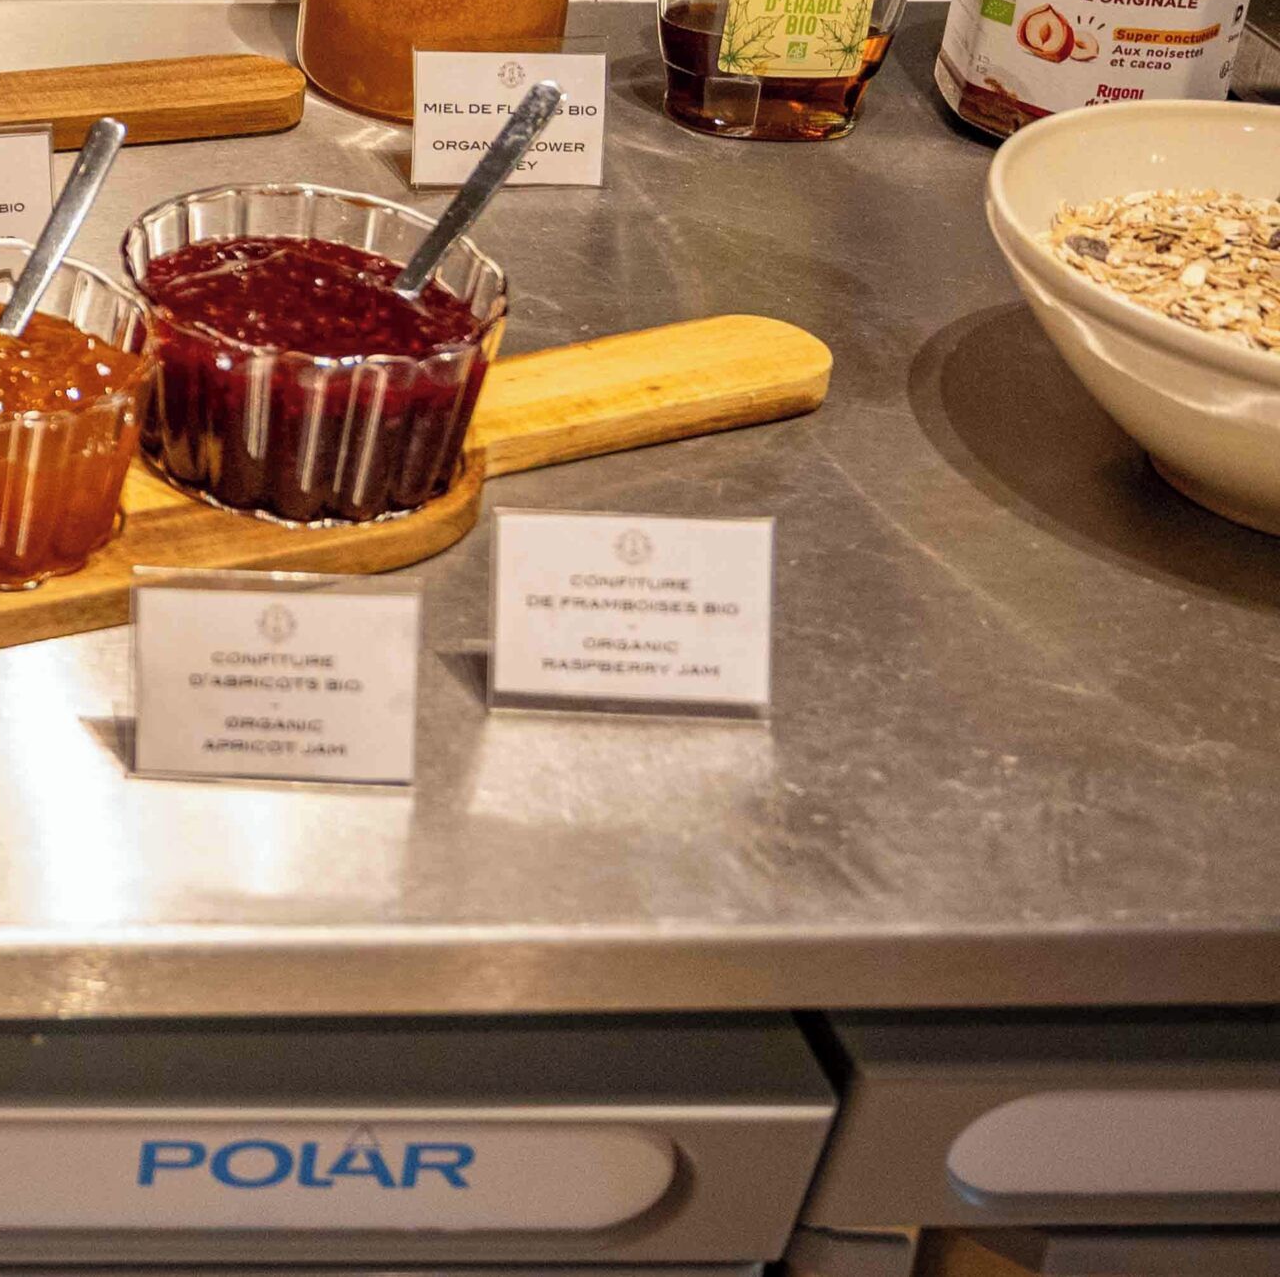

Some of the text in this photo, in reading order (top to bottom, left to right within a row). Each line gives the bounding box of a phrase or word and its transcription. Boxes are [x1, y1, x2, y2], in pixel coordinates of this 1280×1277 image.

[785, 15, 817, 35] BIO
[1116, 29, 1159, 43] Super
[1112, 45, 1140, 56] Aux
[1110, 58, 1172, 70] et cacao
[1096, 84, 1144, 101] Rigoni
[423, 103, 464, 114] MIEL
[469, 103, 492, 114] DE
[568, 105, 598, 116] BIO
[569, 574, 691, 590] CONFITURE
[525, 594, 739, 616] DE FRAMBOISES BIO
[582, 637, 680, 654] ORGANIC
[210, 651, 334, 668] CONFITURE
[541, 657, 722, 680] RASPBERRY JAM
[325, 677, 364, 693] BIO
[224, 716, 324, 732] ORGANIC
[202, 739, 349, 756] APRICOT JAM
[136, 1138, 476, 1190] POLAR
